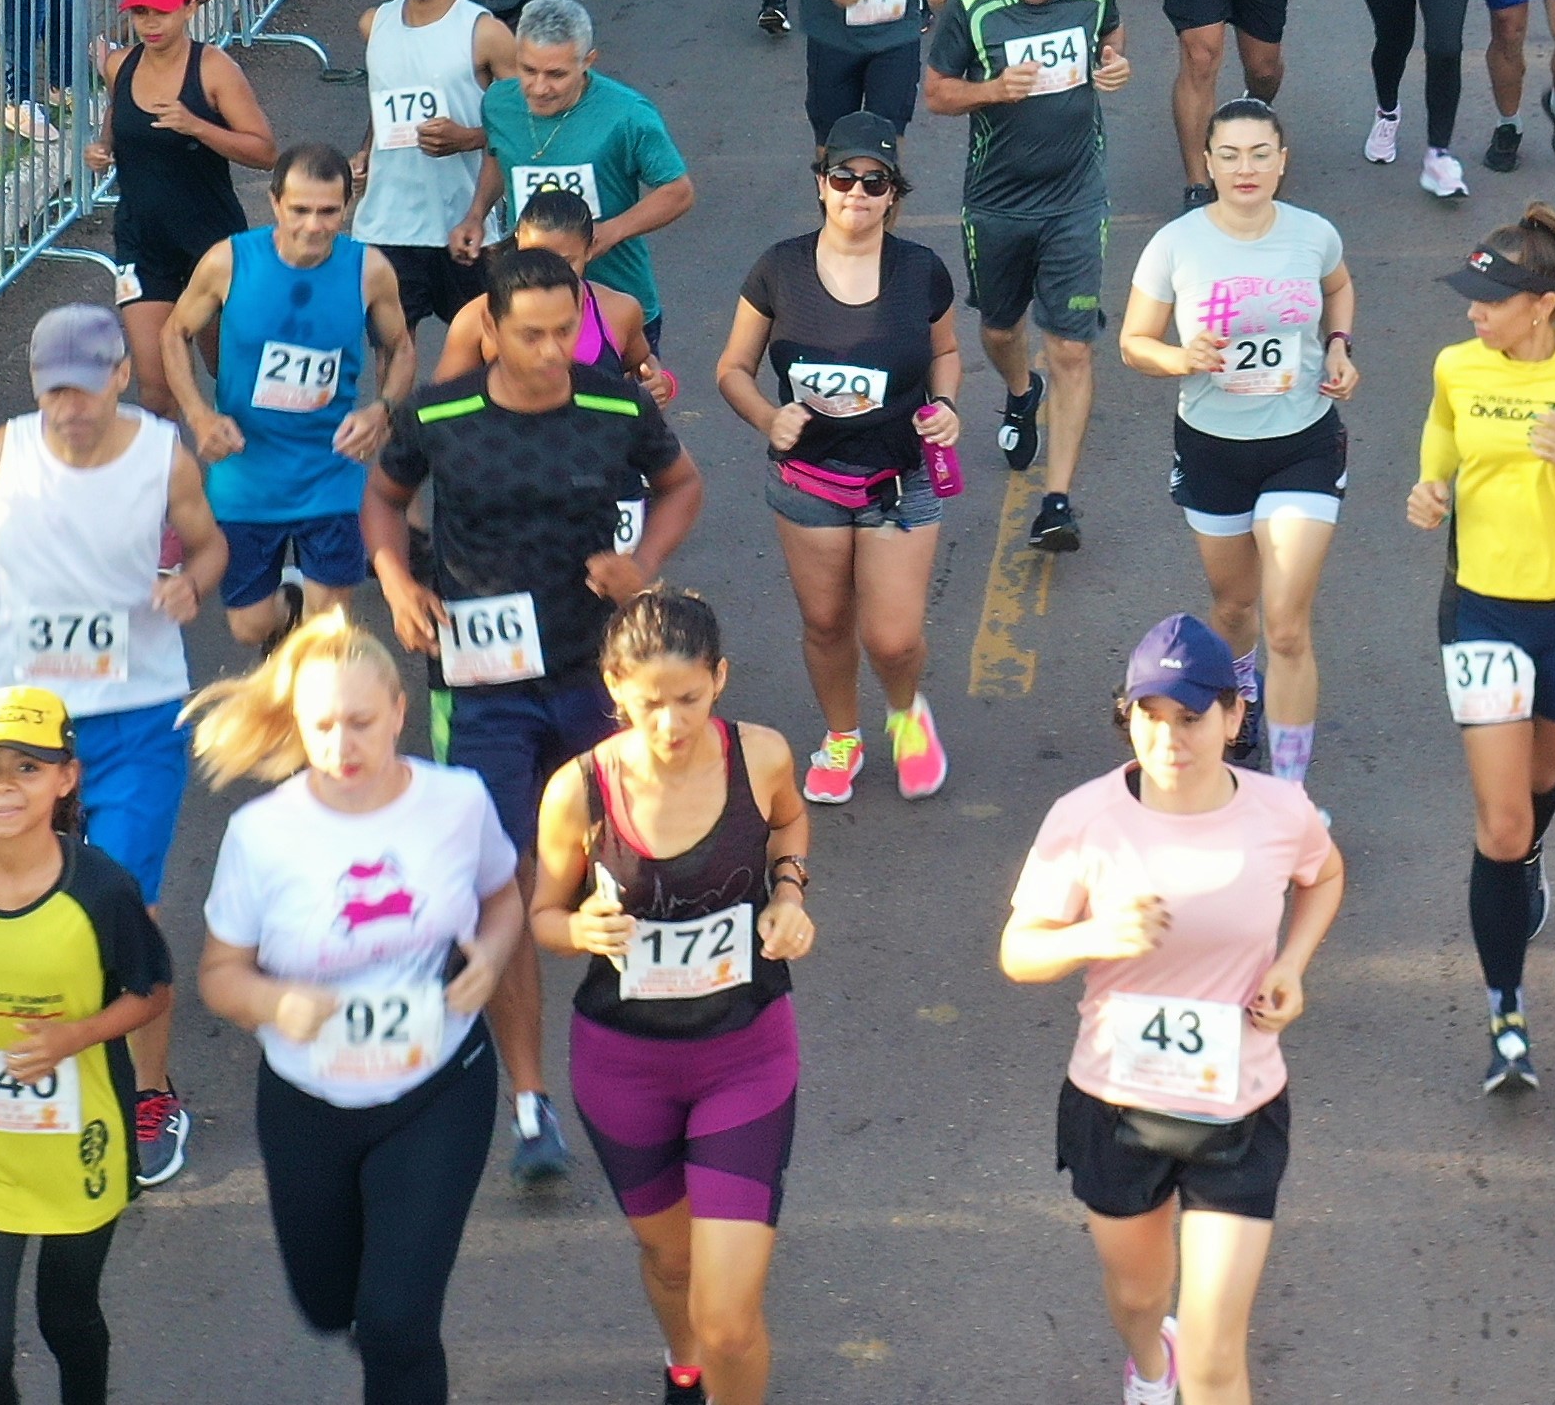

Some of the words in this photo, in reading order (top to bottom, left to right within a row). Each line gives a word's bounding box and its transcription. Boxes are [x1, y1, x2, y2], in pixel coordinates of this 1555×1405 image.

[1020, 36, 1078, 68] 454
[385, 91, 437, 124] 179
[266, 349, 336, 388] 219
[1236, 338, 1282, 371] 26
[801, 372, 871, 399] 429
[29, 613, 113, 652] 376
[447, 606, 523, 651] 166
[1455, 649, 1520, 688] 371
[642, 917, 734, 965] 172
[345, 996, 410, 1045] 92
[1141, 1006, 1204, 1055] 43
